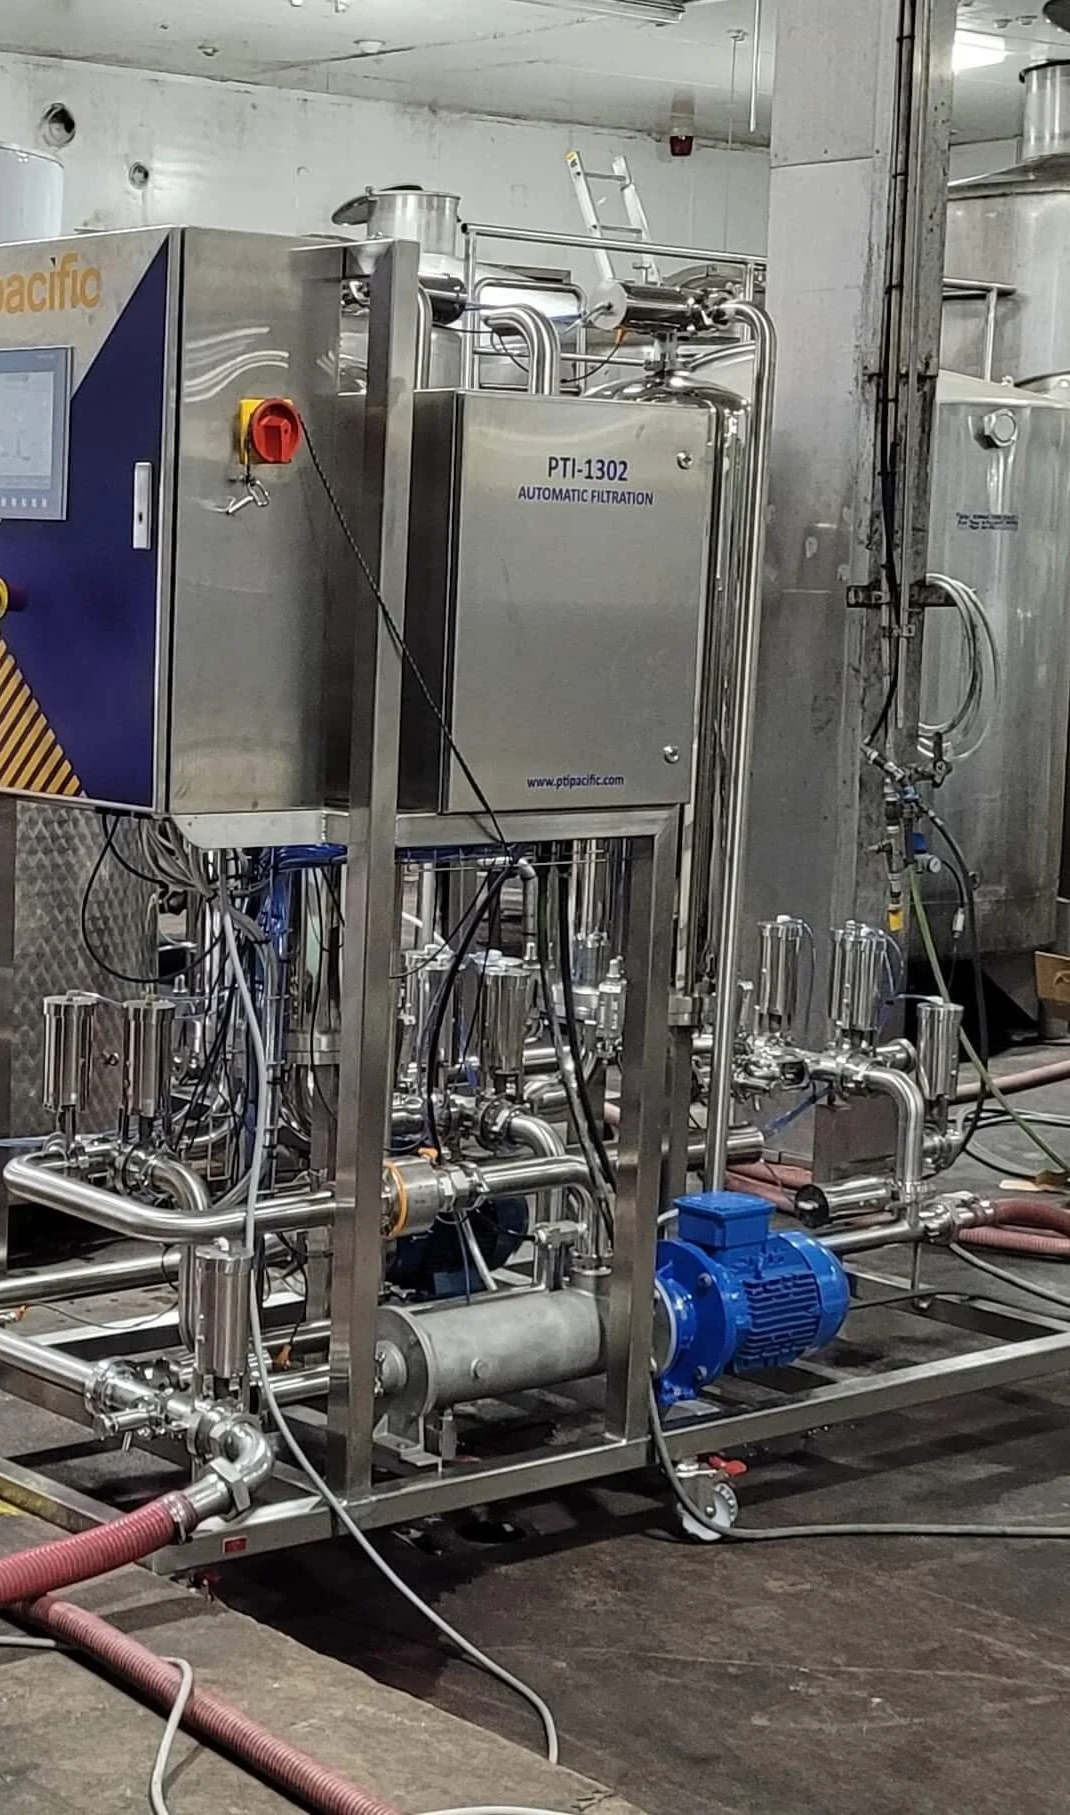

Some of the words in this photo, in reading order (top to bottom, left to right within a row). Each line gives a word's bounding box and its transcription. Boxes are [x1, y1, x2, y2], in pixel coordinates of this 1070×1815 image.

[548, 456, 628, 481] PTI-1302
[518, 486, 589, 503] AUTOMATIC
[591, 489, 654, 505] FILTRATION
[527, 774, 624, 788] www.ptipacific.com
